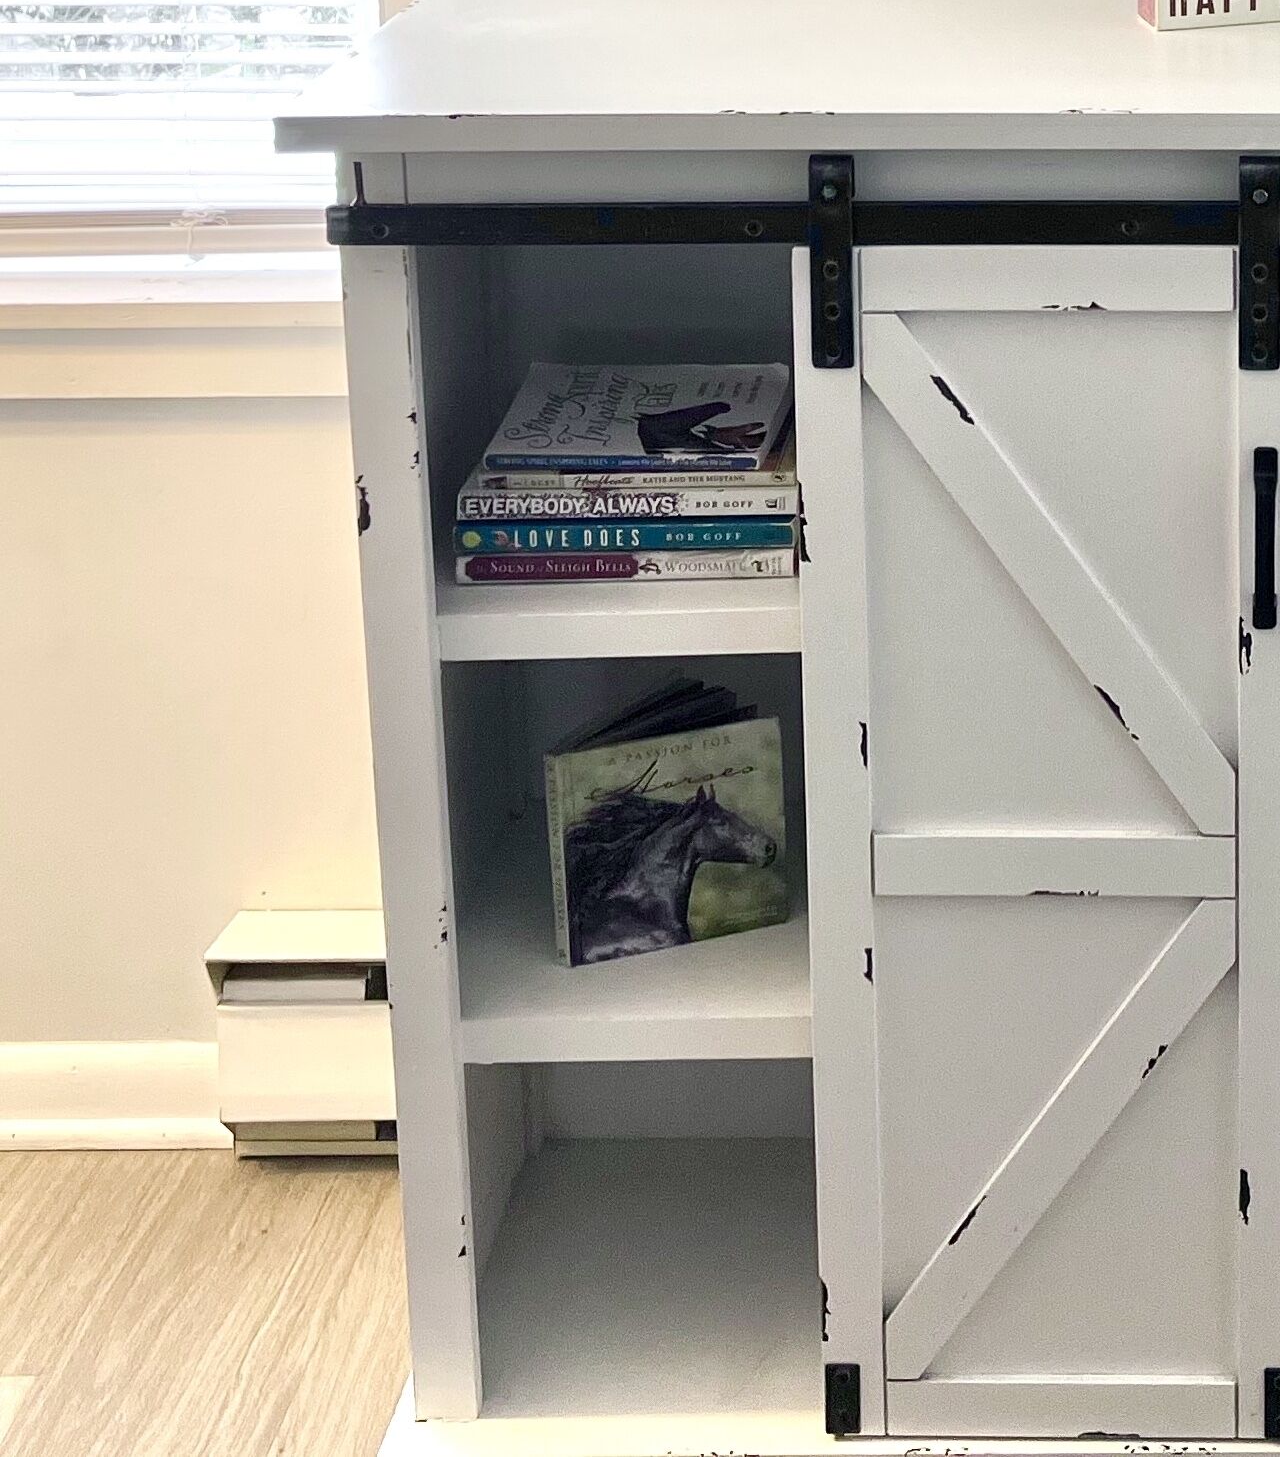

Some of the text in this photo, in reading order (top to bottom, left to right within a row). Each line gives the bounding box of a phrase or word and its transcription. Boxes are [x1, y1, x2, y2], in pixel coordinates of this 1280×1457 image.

[593, 496, 676, 515] ALWAYS
[514, 529, 742, 548] LOVE DOES BOB GOFF
[702, 735, 732, 750] FOR
